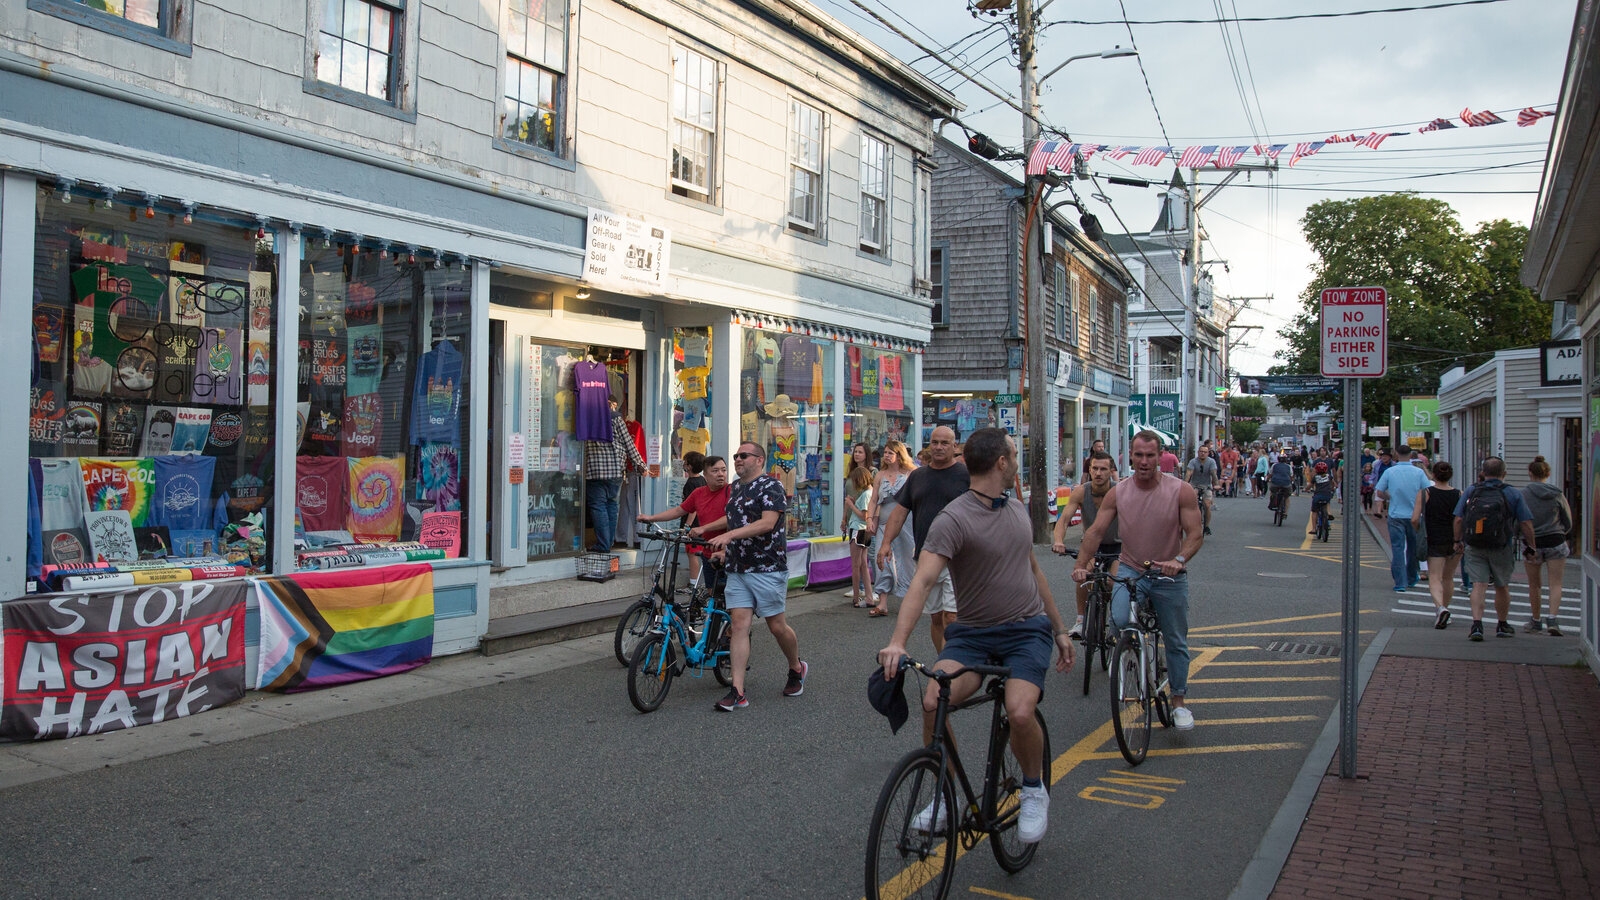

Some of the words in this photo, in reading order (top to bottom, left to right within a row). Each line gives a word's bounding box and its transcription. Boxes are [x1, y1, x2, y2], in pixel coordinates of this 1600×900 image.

[593, 213, 602, 222] All
[604, 215, 620, 227] Your
[592, 226, 622, 241] Off-Road
[591, 238, 608, 249] Gear
[609, 242, 616, 252] Is
[590, 251, 606, 262] Sold
[588, 264, 608, 276] Here!
[1326, 292, 1347, 303] TOW
[1353, 290, 1382, 303] ZONE
[1343, 311, 1364, 322] NO
[1327, 326, 1380, 338] PARKING
[313, 340, 327, 349] SEX
[1330, 341, 1375, 353] EITHER
[313, 348, 339, 359] DRUGS
[313, 357, 319, 365] &
[1338, 356, 1369, 368] SIDE
[313, 364, 346, 375] LOBSTER
[323, 374, 346, 383] ROLLS
[31, 387, 41, 398] EX
[1153, 400, 1174, 411] ANCHOR
[178, 413, 197, 421] CAPE
[30, 417, 63, 431] BSTER
[347, 431, 376, 447] Jeep
[82, 468, 122, 485] CAPE
[127, 467, 155, 484] COD
[528, 494, 556, 510] BLACK
[89, 515, 129, 534] PROVINCETOWN
[47, 581, 215, 636] STOP
[17, 617, 233, 692] ASIAN
[33, 667, 214, 740] HATE
